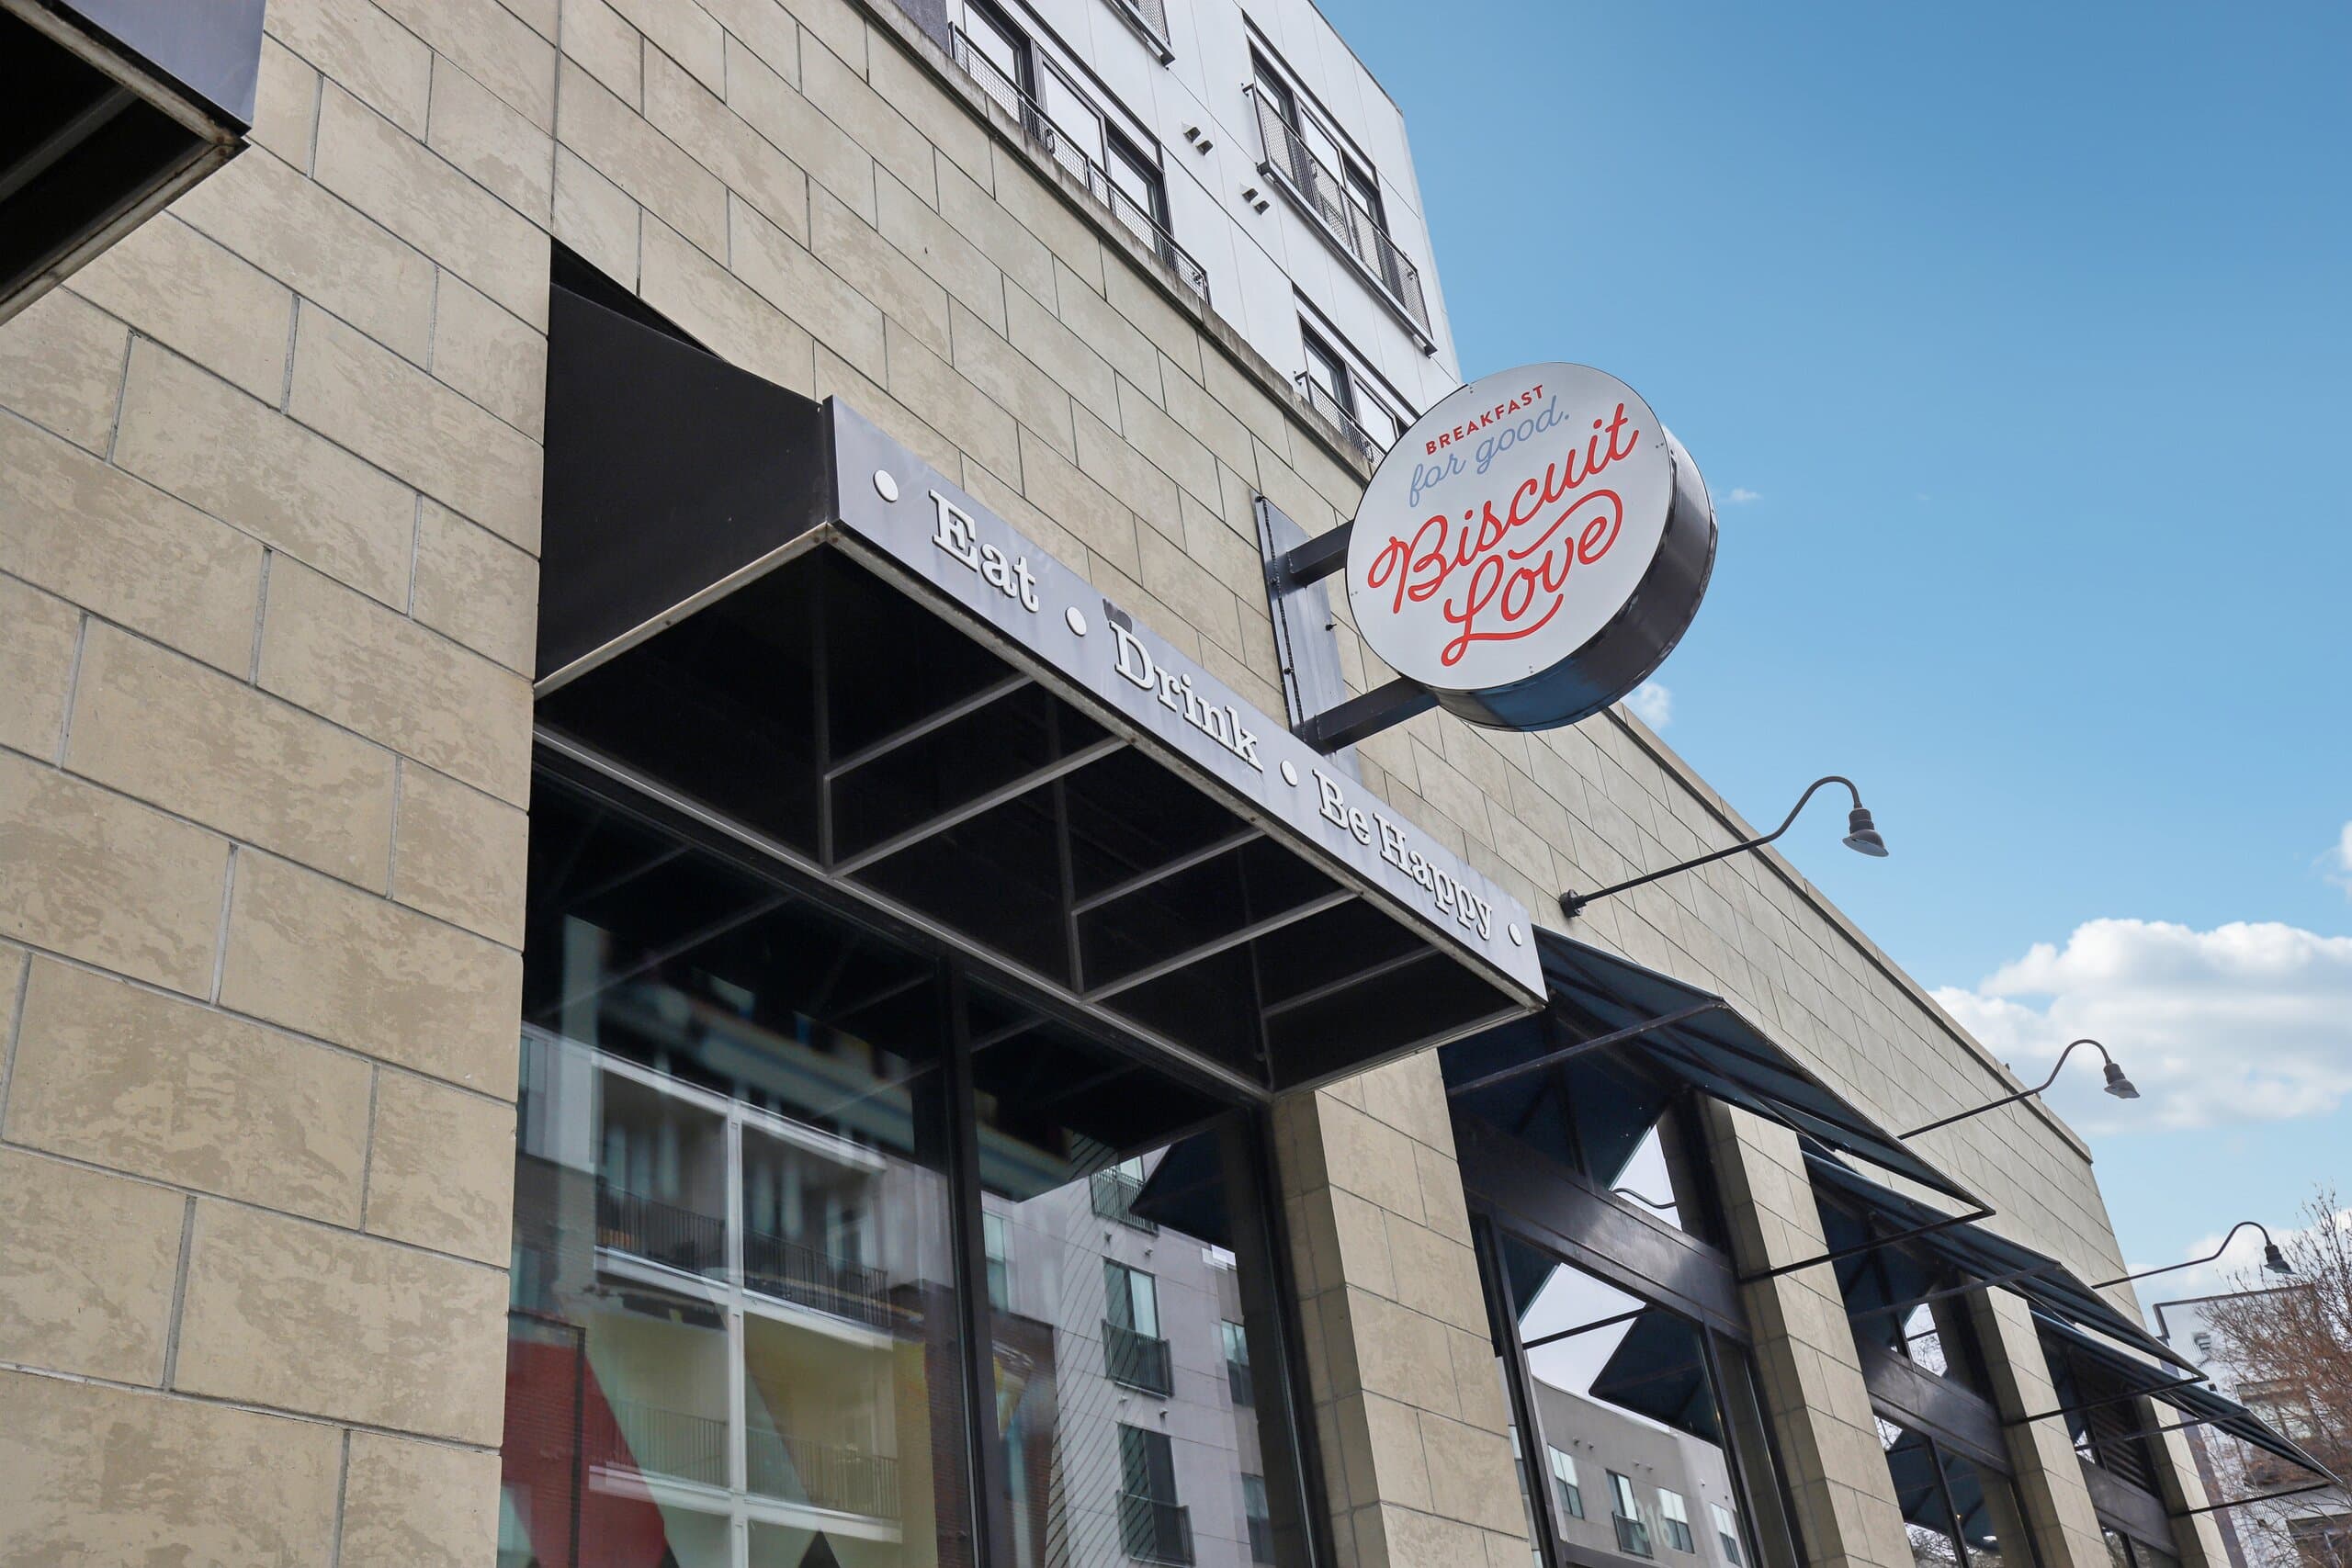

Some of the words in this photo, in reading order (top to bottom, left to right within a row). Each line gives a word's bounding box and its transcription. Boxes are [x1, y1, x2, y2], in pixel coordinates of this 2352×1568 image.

[1367, 402, 1640, 614] Biscuit
[1408, 453, 1467, 508] for
[1475, 395, 1569, 474] good.
[1425, 385, 1544, 456] BREAKFAST
[1441, 489, 1623, 667] Love
[929, 489, 1039, 613] Eat
[1109, 620, 1263, 773] Drink
[1312, 769, 1371, 845] Be
[1373, 813, 1492, 941] Happy
